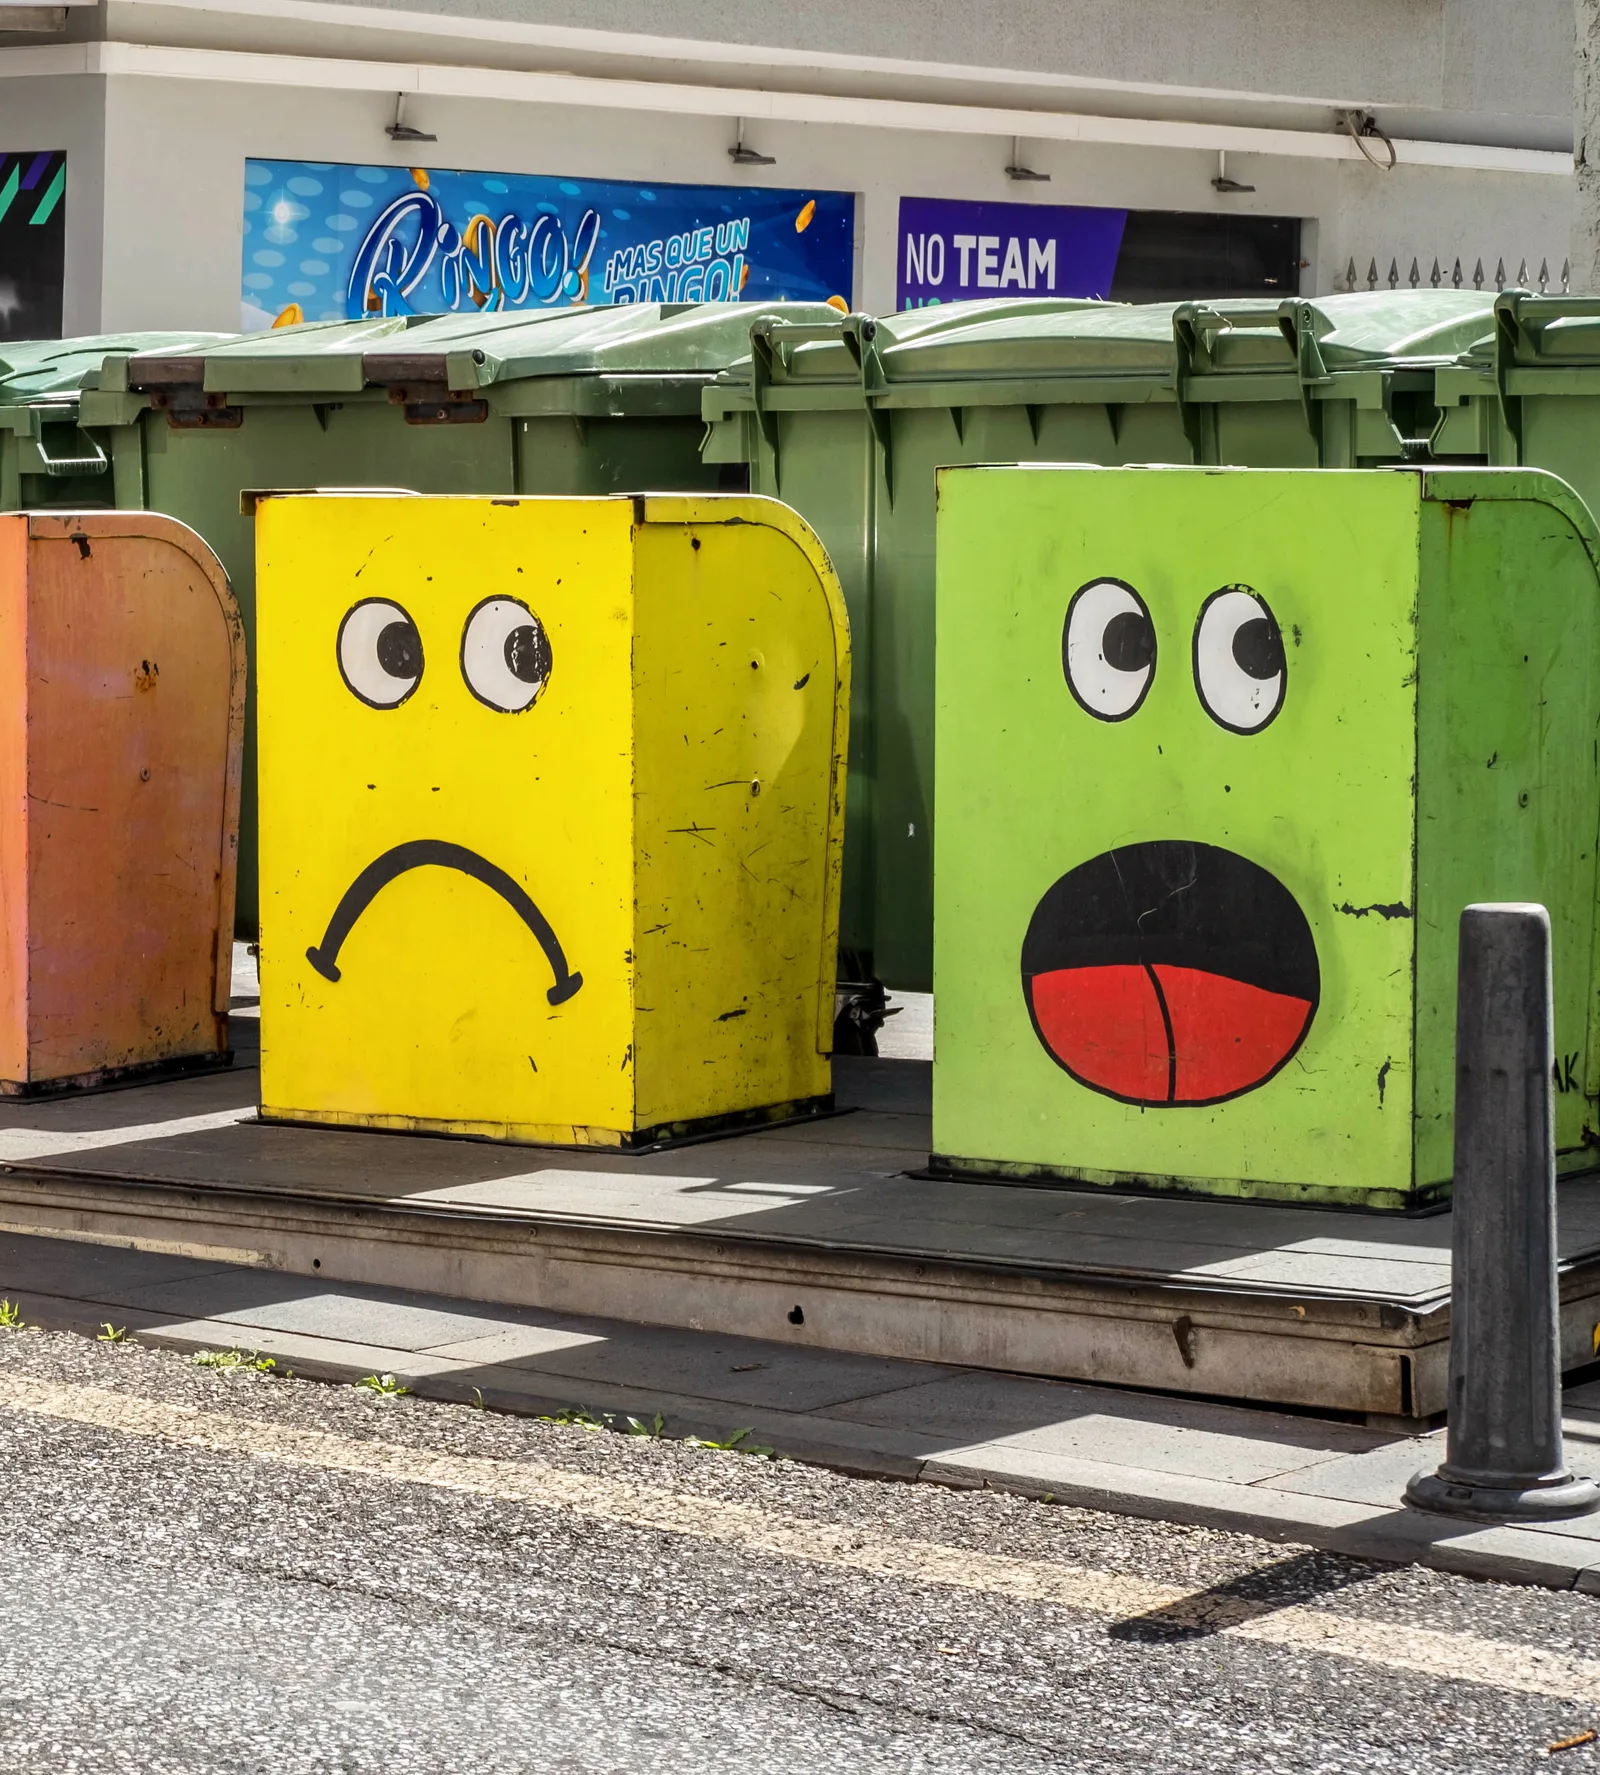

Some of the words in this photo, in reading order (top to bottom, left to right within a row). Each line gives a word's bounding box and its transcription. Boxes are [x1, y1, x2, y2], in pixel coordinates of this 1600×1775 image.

[604, 240, 663, 293] ¡MAS
[665, 226, 714, 269] QUE
[715, 217, 750, 255] UN
[906, 233, 945, 286] NO
[953, 234, 1057, 290] TEAM
